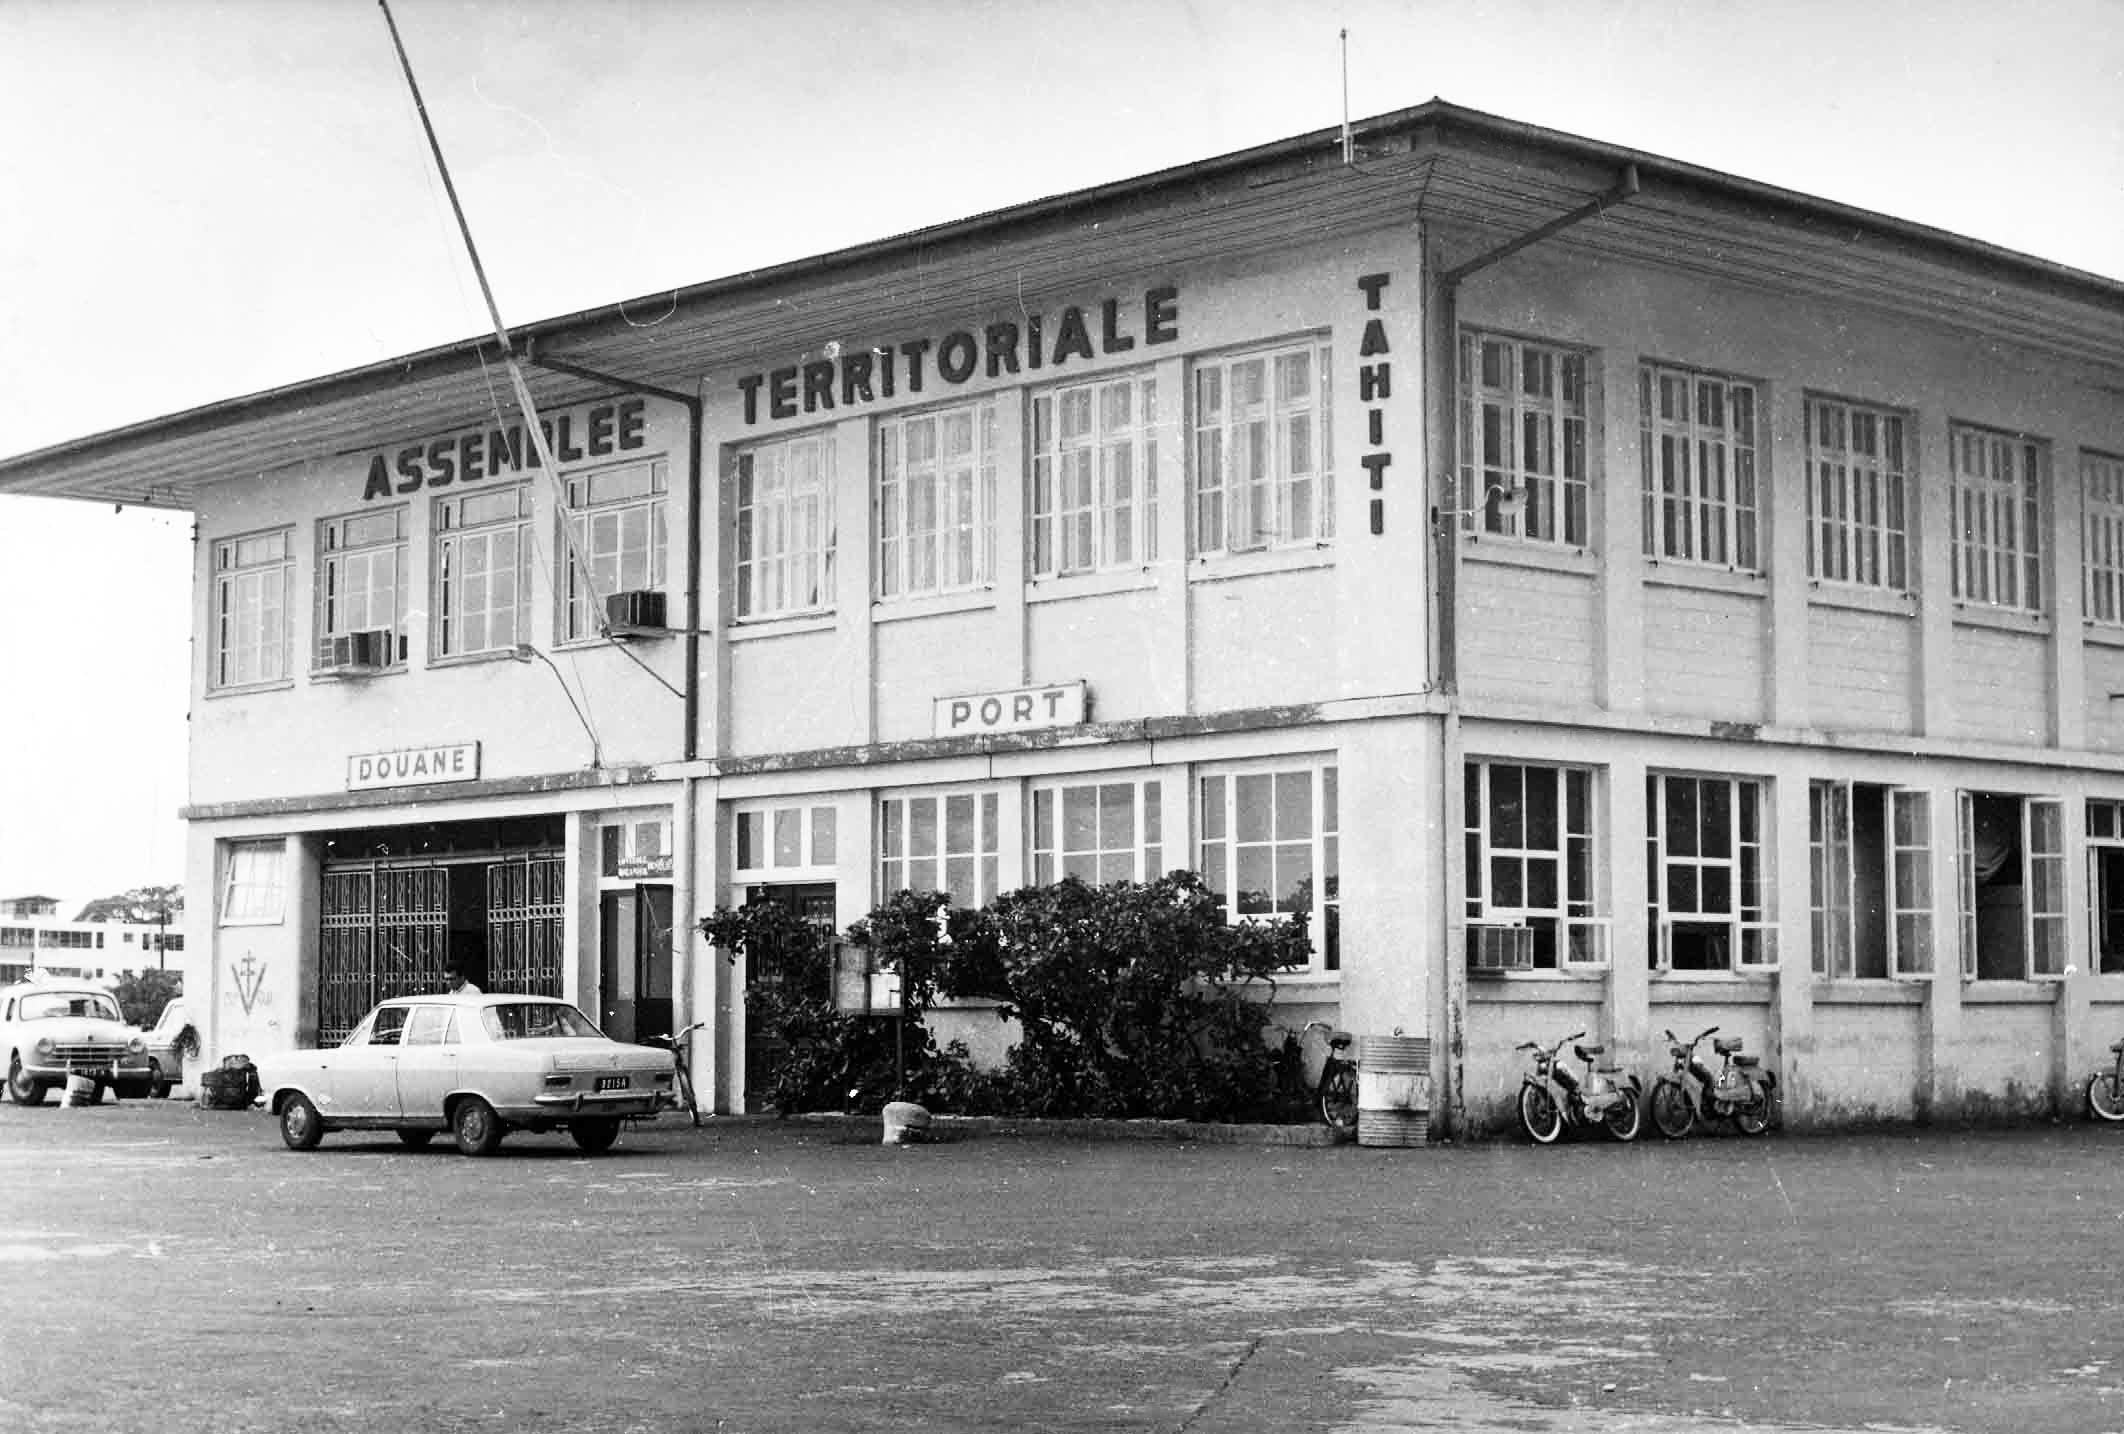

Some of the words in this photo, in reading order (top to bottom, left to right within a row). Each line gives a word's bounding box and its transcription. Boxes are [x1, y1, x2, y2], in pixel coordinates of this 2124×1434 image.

[738, 286, 1179, 425] TERRITORIALE
[1358, 272, 1392, 535] TAHITI
[951, 690, 1065, 729] PORT
[359, 749, 465, 781] DOUANE
